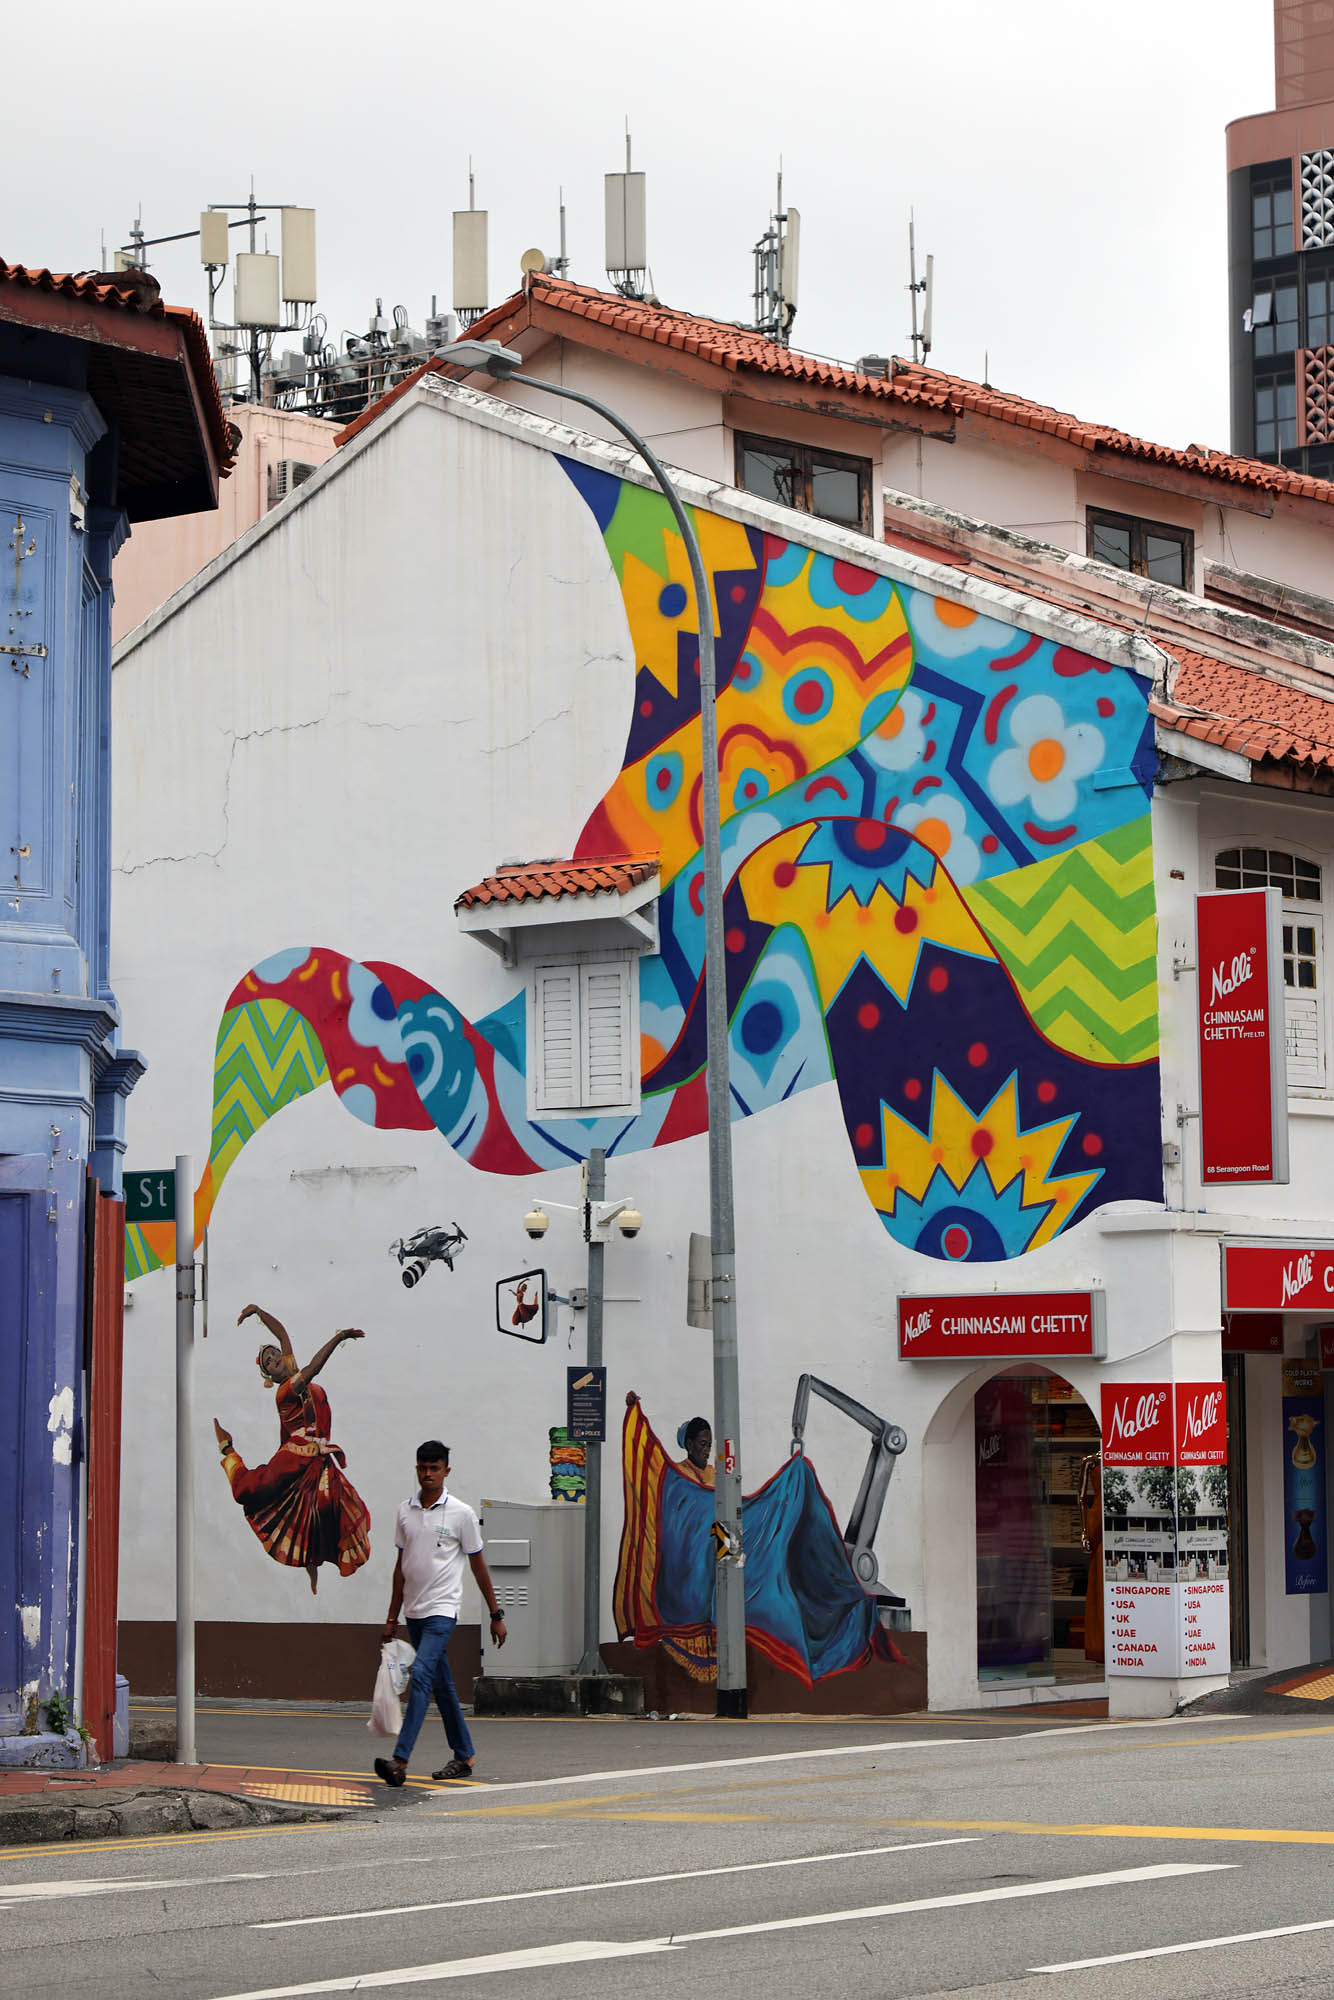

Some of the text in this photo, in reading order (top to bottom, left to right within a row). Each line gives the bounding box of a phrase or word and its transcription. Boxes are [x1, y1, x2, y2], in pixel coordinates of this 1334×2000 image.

[1203, 1009, 1264, 1025] CHINNASAMI
[1204, 1025, 1244, 1041] CHETTY
[1244, 1031, 1254, 1039] PTE
[1216, 1165, 1251, 1174] Serangoon
[139, 1177, 168, 1208] St
[941, 1316, 1026, 1335] CHINNASAMI
[1031, 1314, 1088, 1334] CHETTY
[1103, 1451, 1170, 1461] CHINNASAMI CHETTY
[1115, 1585, 1171, 1596] SINGAPORE
[1187, 1584, 1224, 1595] SINGAPORE
[1115, 1600, 1136, 1609] USA
[1187, 1600, 1201, 1609] USA
[1116, 1614, 1130, 1623] UK
[1187, 1615, 1197, 1624] UK
[1116, 1628, 1137, 1638] UAE
[1187, 1629, 1202, 1638] UAE
[1117, 1643, 1158, 1653] CANADA
[1188, 1642, 1216, 1652] CANADA
[1117, 1657, 1144, 1667] INDIA
[1188, 1657, 1207, 1667] INDIA
